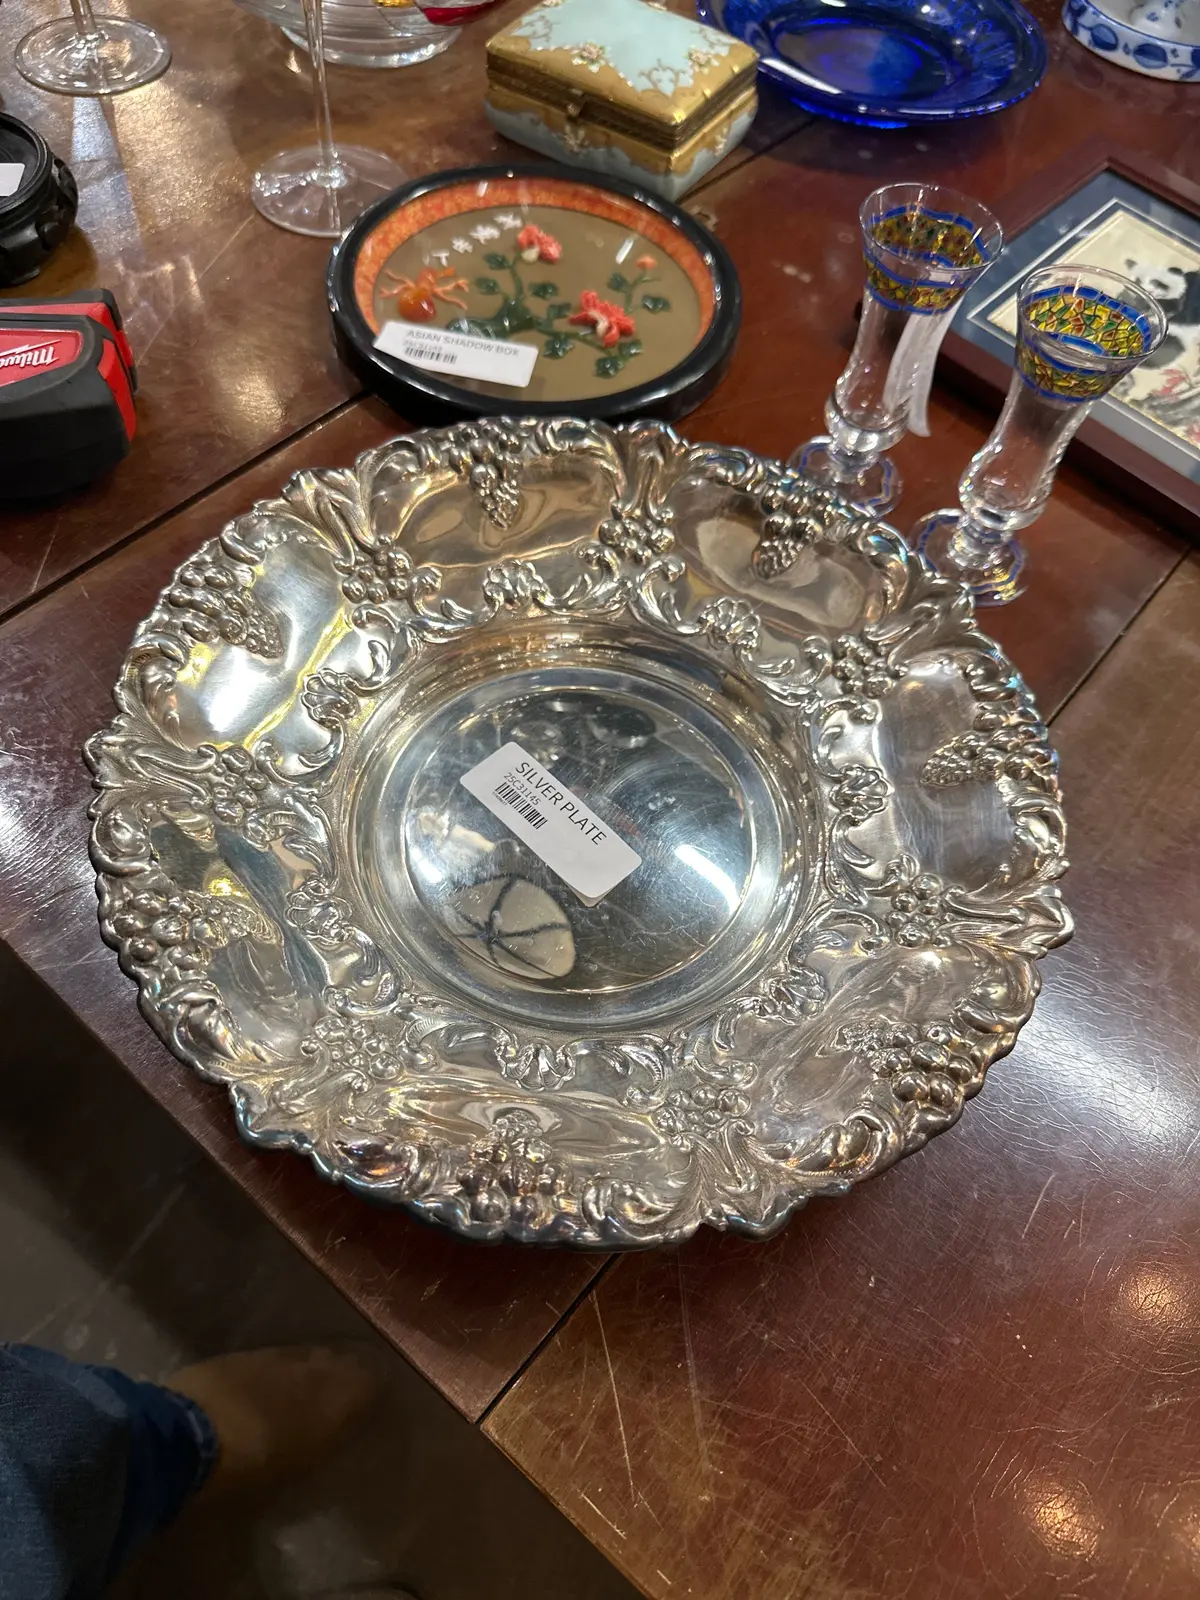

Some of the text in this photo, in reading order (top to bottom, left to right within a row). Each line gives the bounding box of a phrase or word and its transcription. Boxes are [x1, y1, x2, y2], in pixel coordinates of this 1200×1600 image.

[407, 330, 520, 357] ASIAN SHADOW BOX
[503, 772, 541, 806] 25C31145
[515, 761, 607, 845] SILVER PLATE
